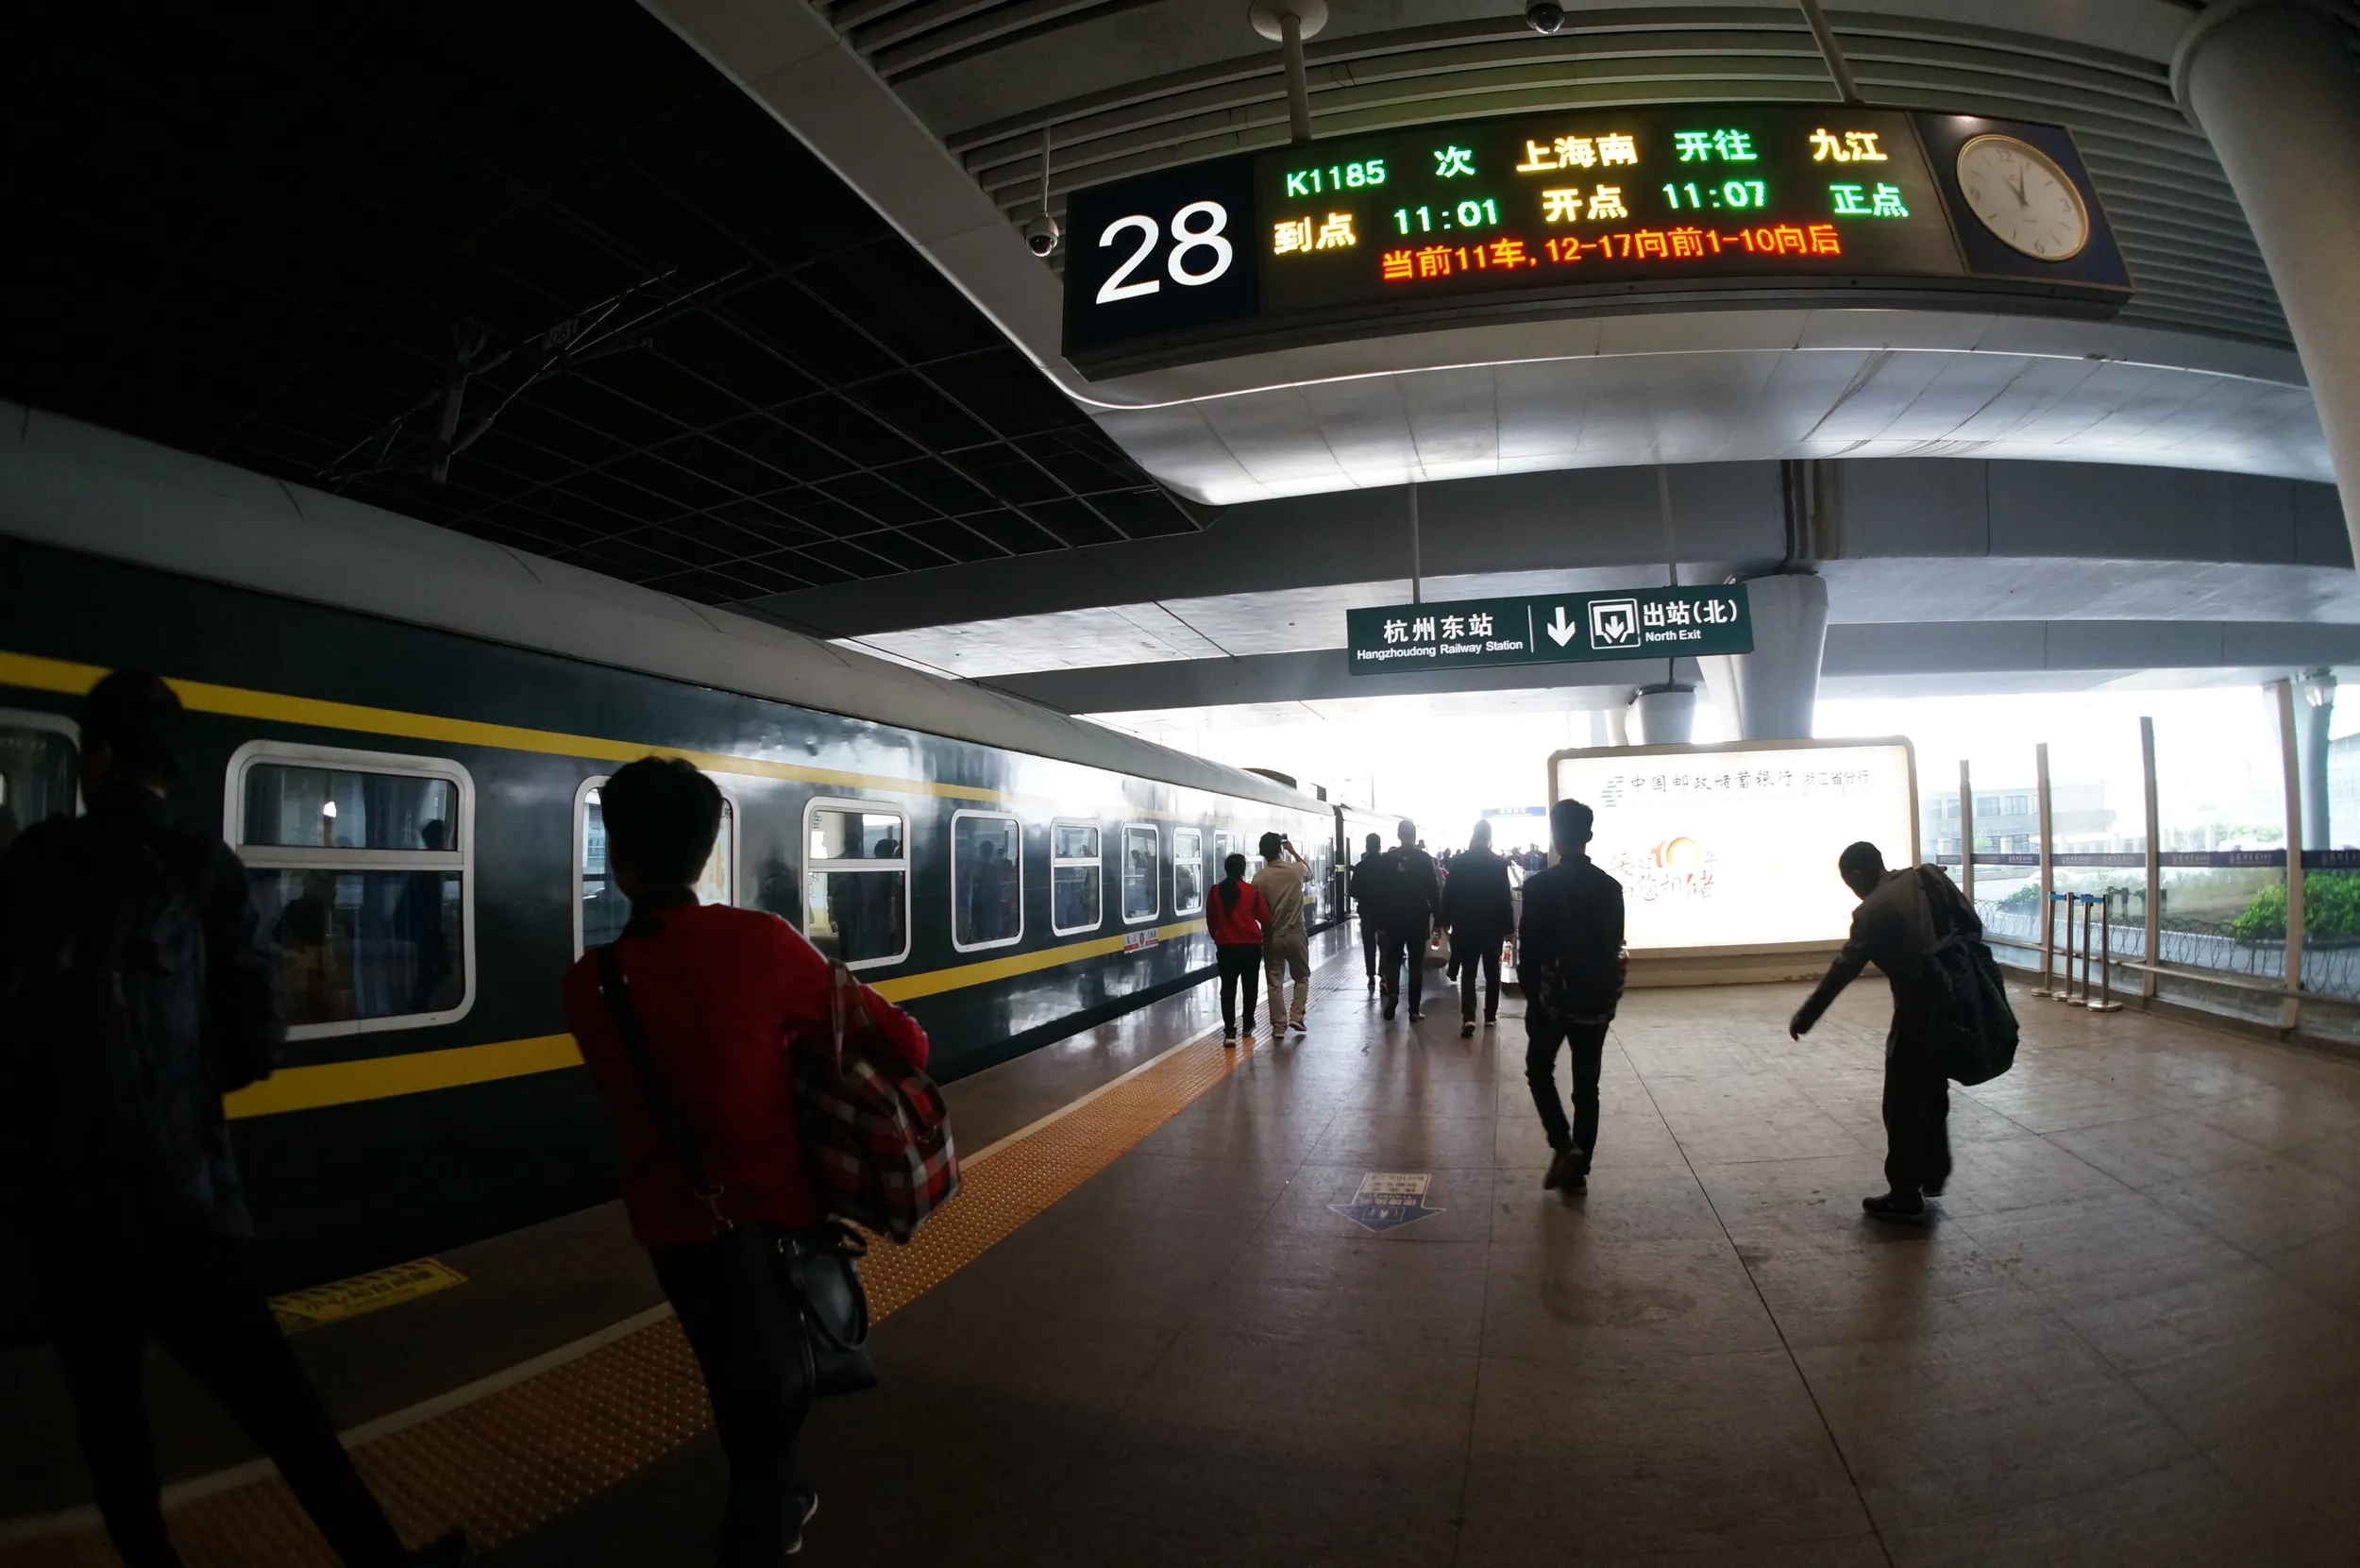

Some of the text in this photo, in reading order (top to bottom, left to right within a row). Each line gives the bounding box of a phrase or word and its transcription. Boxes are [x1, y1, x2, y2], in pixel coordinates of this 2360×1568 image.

[1287, 128, 1888, 197] K1185 次 上海南 开往 九江
[1274, 179, 1910, 255] 到点 11:01 开点 11:07 正点
[1096, 201, 1233, 305] 28
[2034, 240, 2045, 254] 6
[1384, 613, 1493, 644] 杭州东站
[1645, 629, 1702, 642] North Exit
[1357, 633, 1524, 661] Hangzhoudong Railway Station
[1630, 770, 1793, 795] 中国邮政储蓄银行
